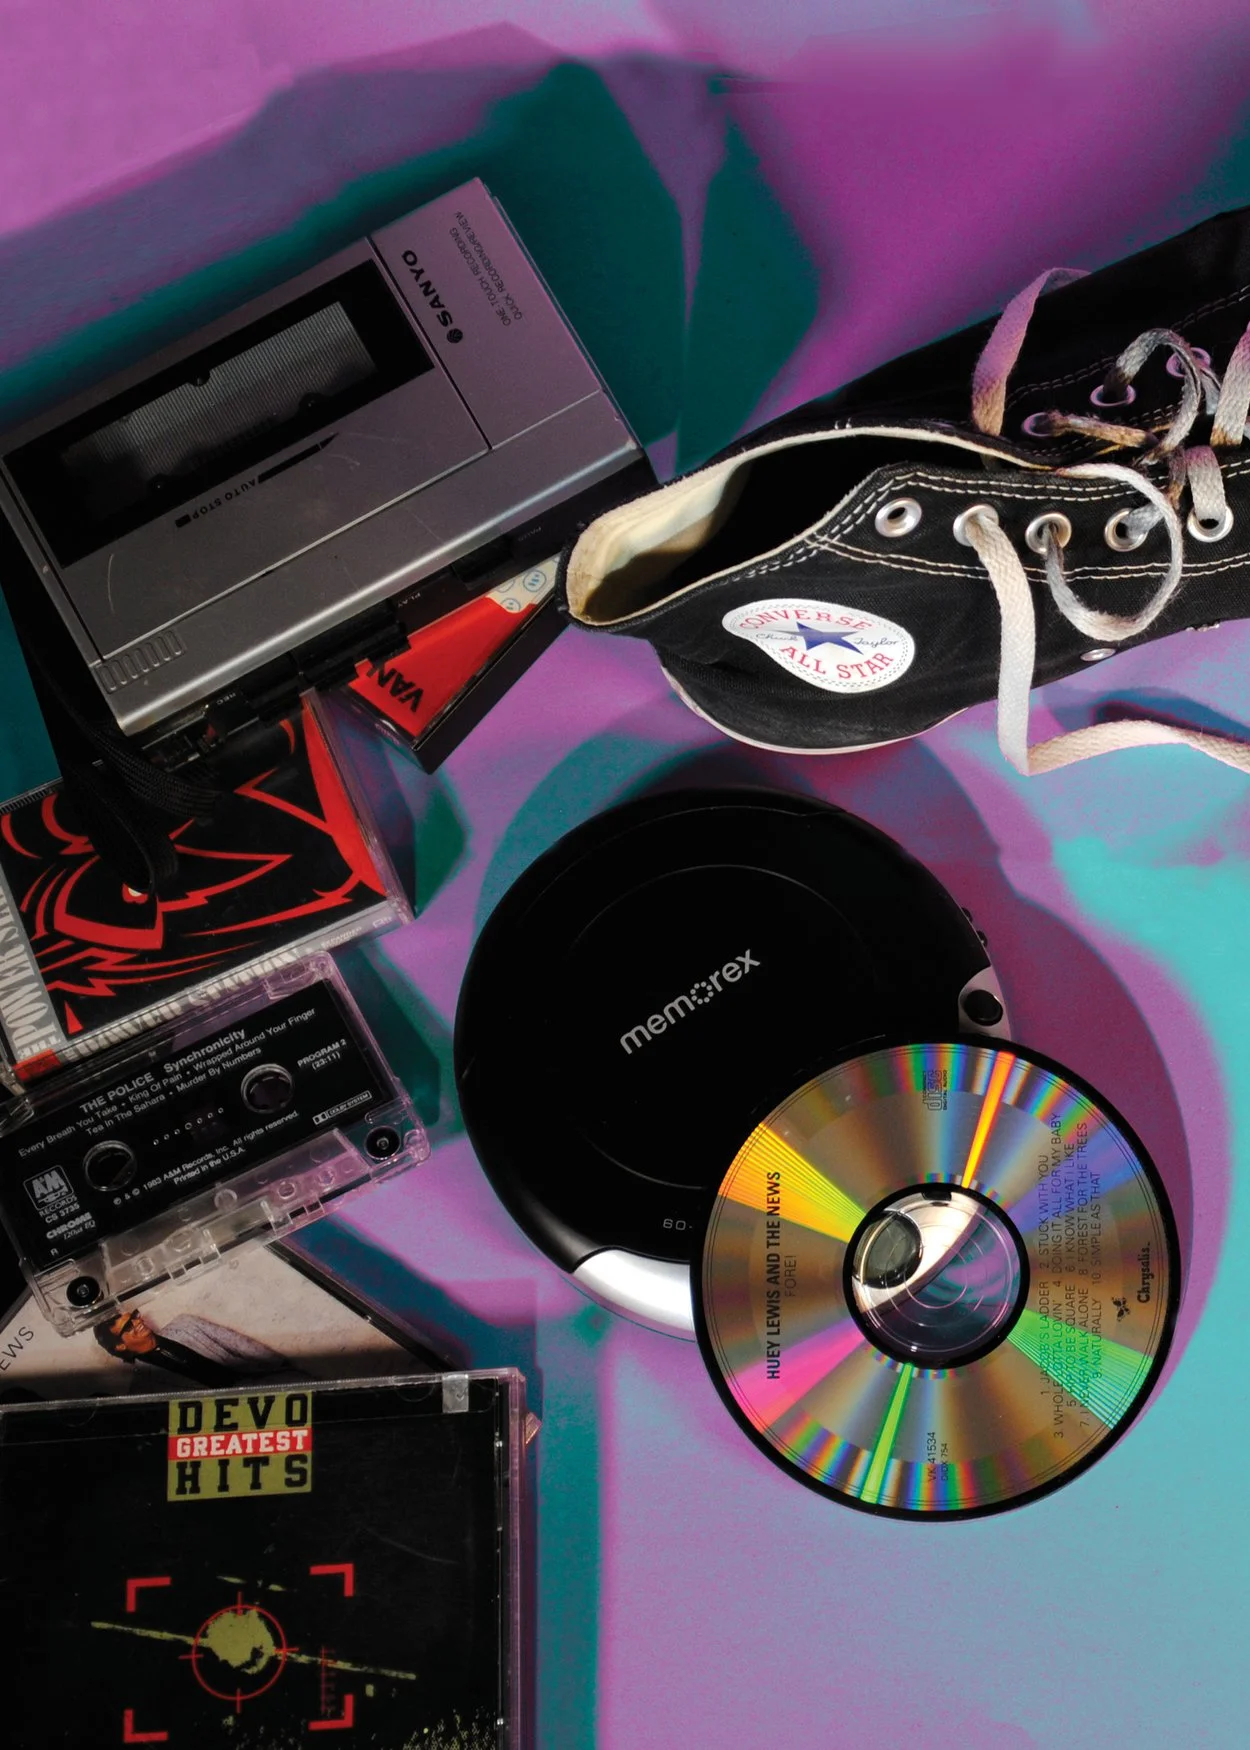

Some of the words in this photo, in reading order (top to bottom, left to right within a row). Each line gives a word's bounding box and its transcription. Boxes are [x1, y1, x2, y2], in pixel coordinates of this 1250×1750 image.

[400, 247, 454, 329] SANYO
[502, 292, 523, 321] QUICK
[223, 477, 257, 501] AUTO
[189, 496, 223, 519] STOP
[740, 609, 873, 630] CONVERSE
[755, 633, 800, 641] Chuck
[854, 637, 899, 647] Taylor
[780, 645, 826, 675] ALL
[836, 653, 894, 679] STAR
[365, 667, 423, 713] VAN
[620, 949, 761, 1054] memorex
[296, 1041, 340, 1067] PROGRAM
[339, 1038, 346, 1046] 2
[310, 1050, 341, 1070] (23:11)
[45, 1123, 76, 1144] Breath
[75, 1114, 94, 1129] You
[95, 1103, 118, 1119] Take
[127, 1087, 150, 1105] King
[149, 1081, 162, 1093] Of
[161, 1071, 183, 1087] Pain
[192, 1046, 234, 1073] Wrapped
[233, 1031, 266, 1052] Around
[265, 1020, 288, 1036] Your
[286, 1006, 317, 1027] Finger
[79, 1094, 107, 1114] THE
[106, 1071, 154, 1101] POLICE
[162, 1026, 247, 1075] Synchronicity
[85, 1122, 104, 1136] Tea
[103, 1117, 114, 1127] In
[114, 1108, 133, 1122] The
[132, 1092, 166, 1113] Sahara
[175, 1071, 207, 1093] Murder
[207, 1064, 222, 1078] By
[221, 1045, 262, 1070] Numbers
[1051, 1112, 1061, 1143] BABY
[1077, 1122, 1087, 1159] TREES
[142, 1176, 162, 1190] 1983
[161, 1166, 182, 1181] A&M
[181, 1150, 215, 1172] Records,
[214, 1143, 229, 1155] Inc.
[231, 1136, 243, 1147] All
[242, 1126, 265, 1142] rights
[263, 1109, 299, 1131] reserved.
[173, 1167, 201, 1185] Printed
[200, 1163, 209, 1172] in
[208, 1157, 222, 1168] the
[221, 1145, 246, 1161] U.S.A.
[1051, 1147, 1061, 1166] MY
[1064, 1143, 1074, 1168] LIKE
[1038, 1154, 1048, 1179] YOU
[1051, 1169, 1061, 1193] FOR
[1078, 1163, 1087, 1185] THE
[766, 1171, 780, 1216] NEWS
[1038, 1183, 1048, 1214] WITH
[1064, 1176, 1074, 1212] WHAT
[1078, 1188, 1087, 1213] FOR
[1091, 1171, 1100, 1200] THAT
[38, 1193, 78, 1217] RECORDS
[44, 1212, 58, 1224] CS
[1052, 1197, 1061, 1218] ALL
[1091, 1203, 1100, 1219] AS
[44, 1211, 92, 1239] CHROME
[766, 1220, 780, 1248] THE
[1038, 1216, 1048, 1254] STUCK
[1052, 1221, 1061, 1231] IT
[1064, 1215, 1074, 1253] KNOW
[1078, 1216, 1087, 1262] FOREST
[1052, 1235, 1061, 1273] DOING
[1091, 1221, 1101, 1265] SIMPLE
[766, 1252, 780, 1285] AND
[784, 1254, 796, 1297] FORE!
[766, 1290, 780, 1335] LEWIS
[1039, 1280, 1049, 1328] LADDER
[1053, 1299, 1062, 1336] LOVIN'
[1065, 1284, 1075, 1333] SQUARE
[1078, 1288, 1088, 1327] ALONE
[1066, 1337, 1075, 1352] BE
[1091, 1297, 1101, 1364] NATURALLY
[766, 1340, 780, 1379] HUEY
[1066, 1354, 1075, 1369] TO
[1078, 1331, 1088, 1364] WALK
[176, 1391, 309, 1435] DEVO
[1054, 1381, 1063, 1425] WHOLE
[176, 1430, 309, 1458] GREATEST
[926, 1431, 936, 1463] 41534
[175, 1456, 309, 1496] HITS
[927, 1467, 936, 1481] VK
